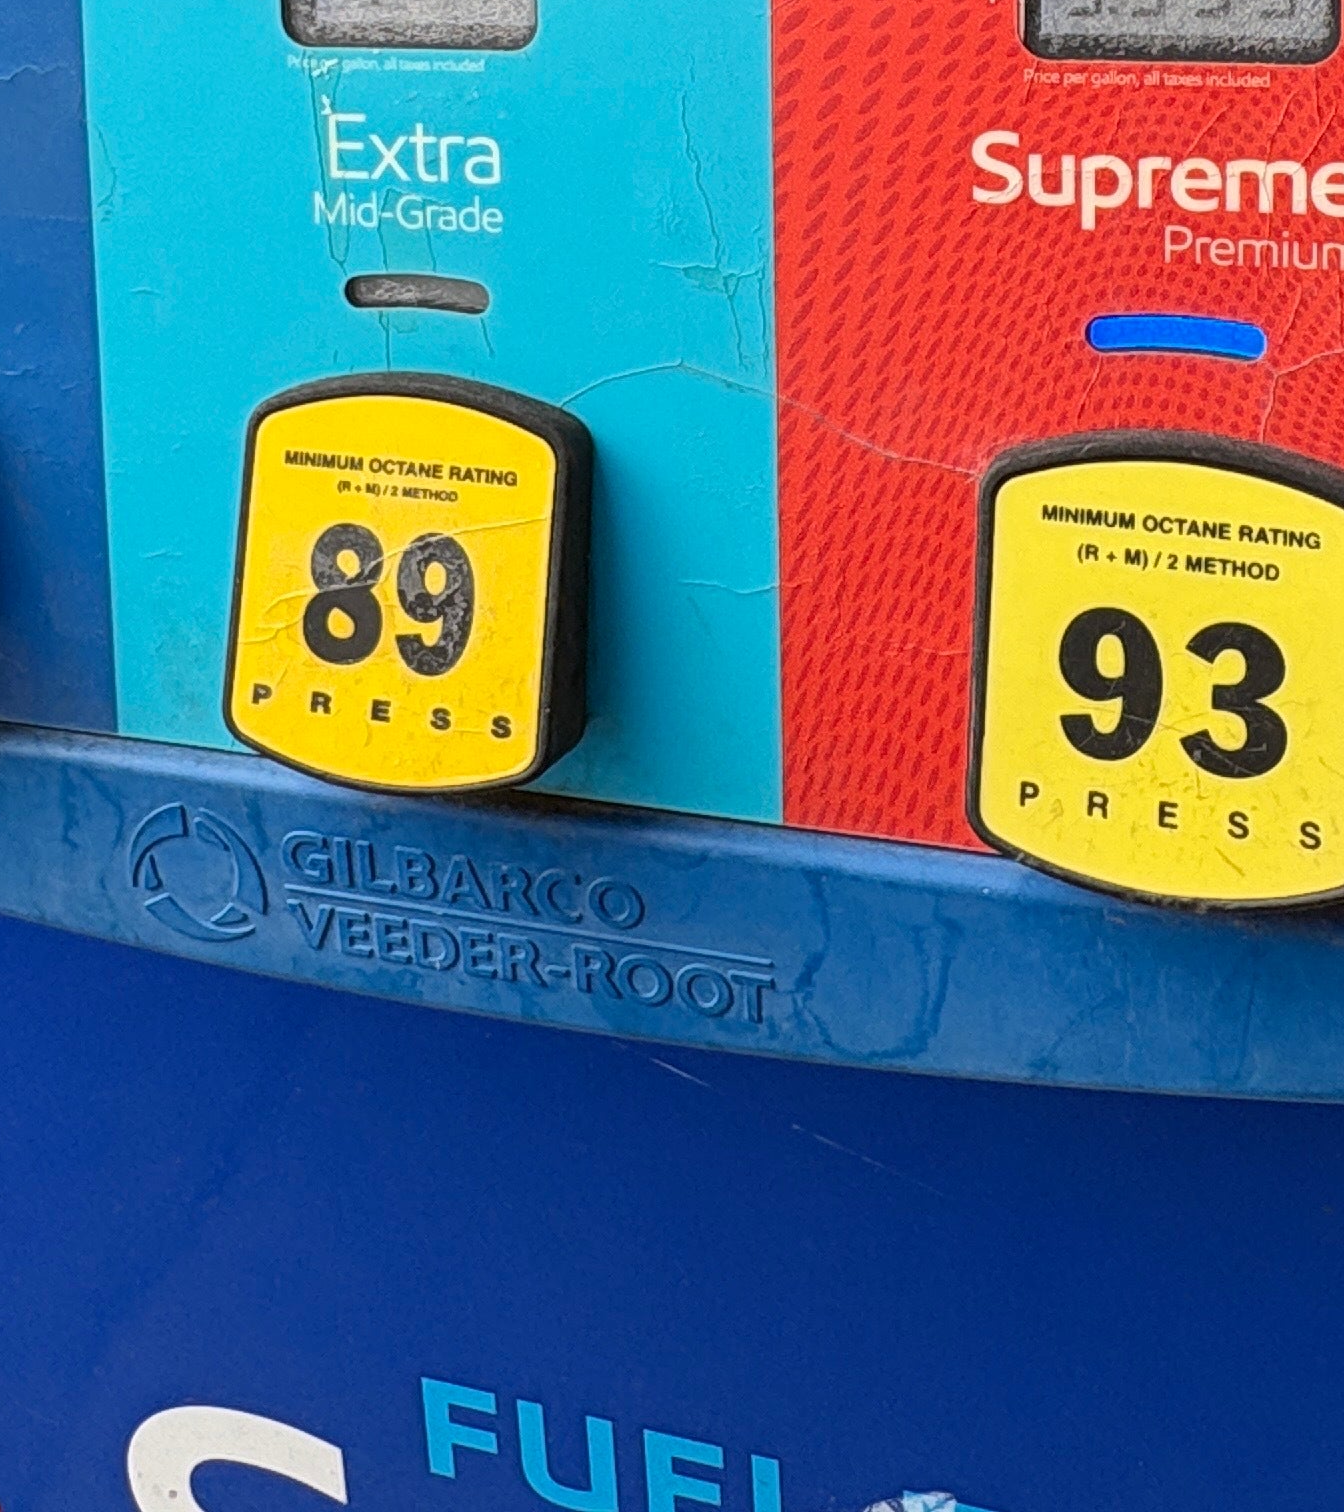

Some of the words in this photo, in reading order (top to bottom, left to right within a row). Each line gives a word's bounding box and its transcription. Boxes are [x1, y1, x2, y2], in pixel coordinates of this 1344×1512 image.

[1023, 68, 1060, 84] Price
[1063, 71, 1087, 88] per
[1091, 70, 1139, 88] gallon,
[1144, 70, 1160, 86] all
[1163, 72, 1202, 87] taxes
[1206, 71, 1271, 88] included
[328, 113, 502, 185] Extra
[313, 191, 504, 234] Mid-Grade
[284, 450, 364, 471] MINIMUM
[369, 457, 443, 479] OCTANE
[449, 465, 518, 486] RATING
[402, 487, 458, 502] METHOD
[1042, 504, 1136, 530] MINIMUM
[1142, 514, 1231, 540] OCTANE
[1238, 525, 1321, 550] RATING
[1185, 555, 1280, 581] METHOD
[303, 523, 474, 676] 89
[1058, 606, 1288, 779] 93
[282, 830, 646, 930] GILBARCO
[286, 897, 776, 1023] VEEDER-ROOT
